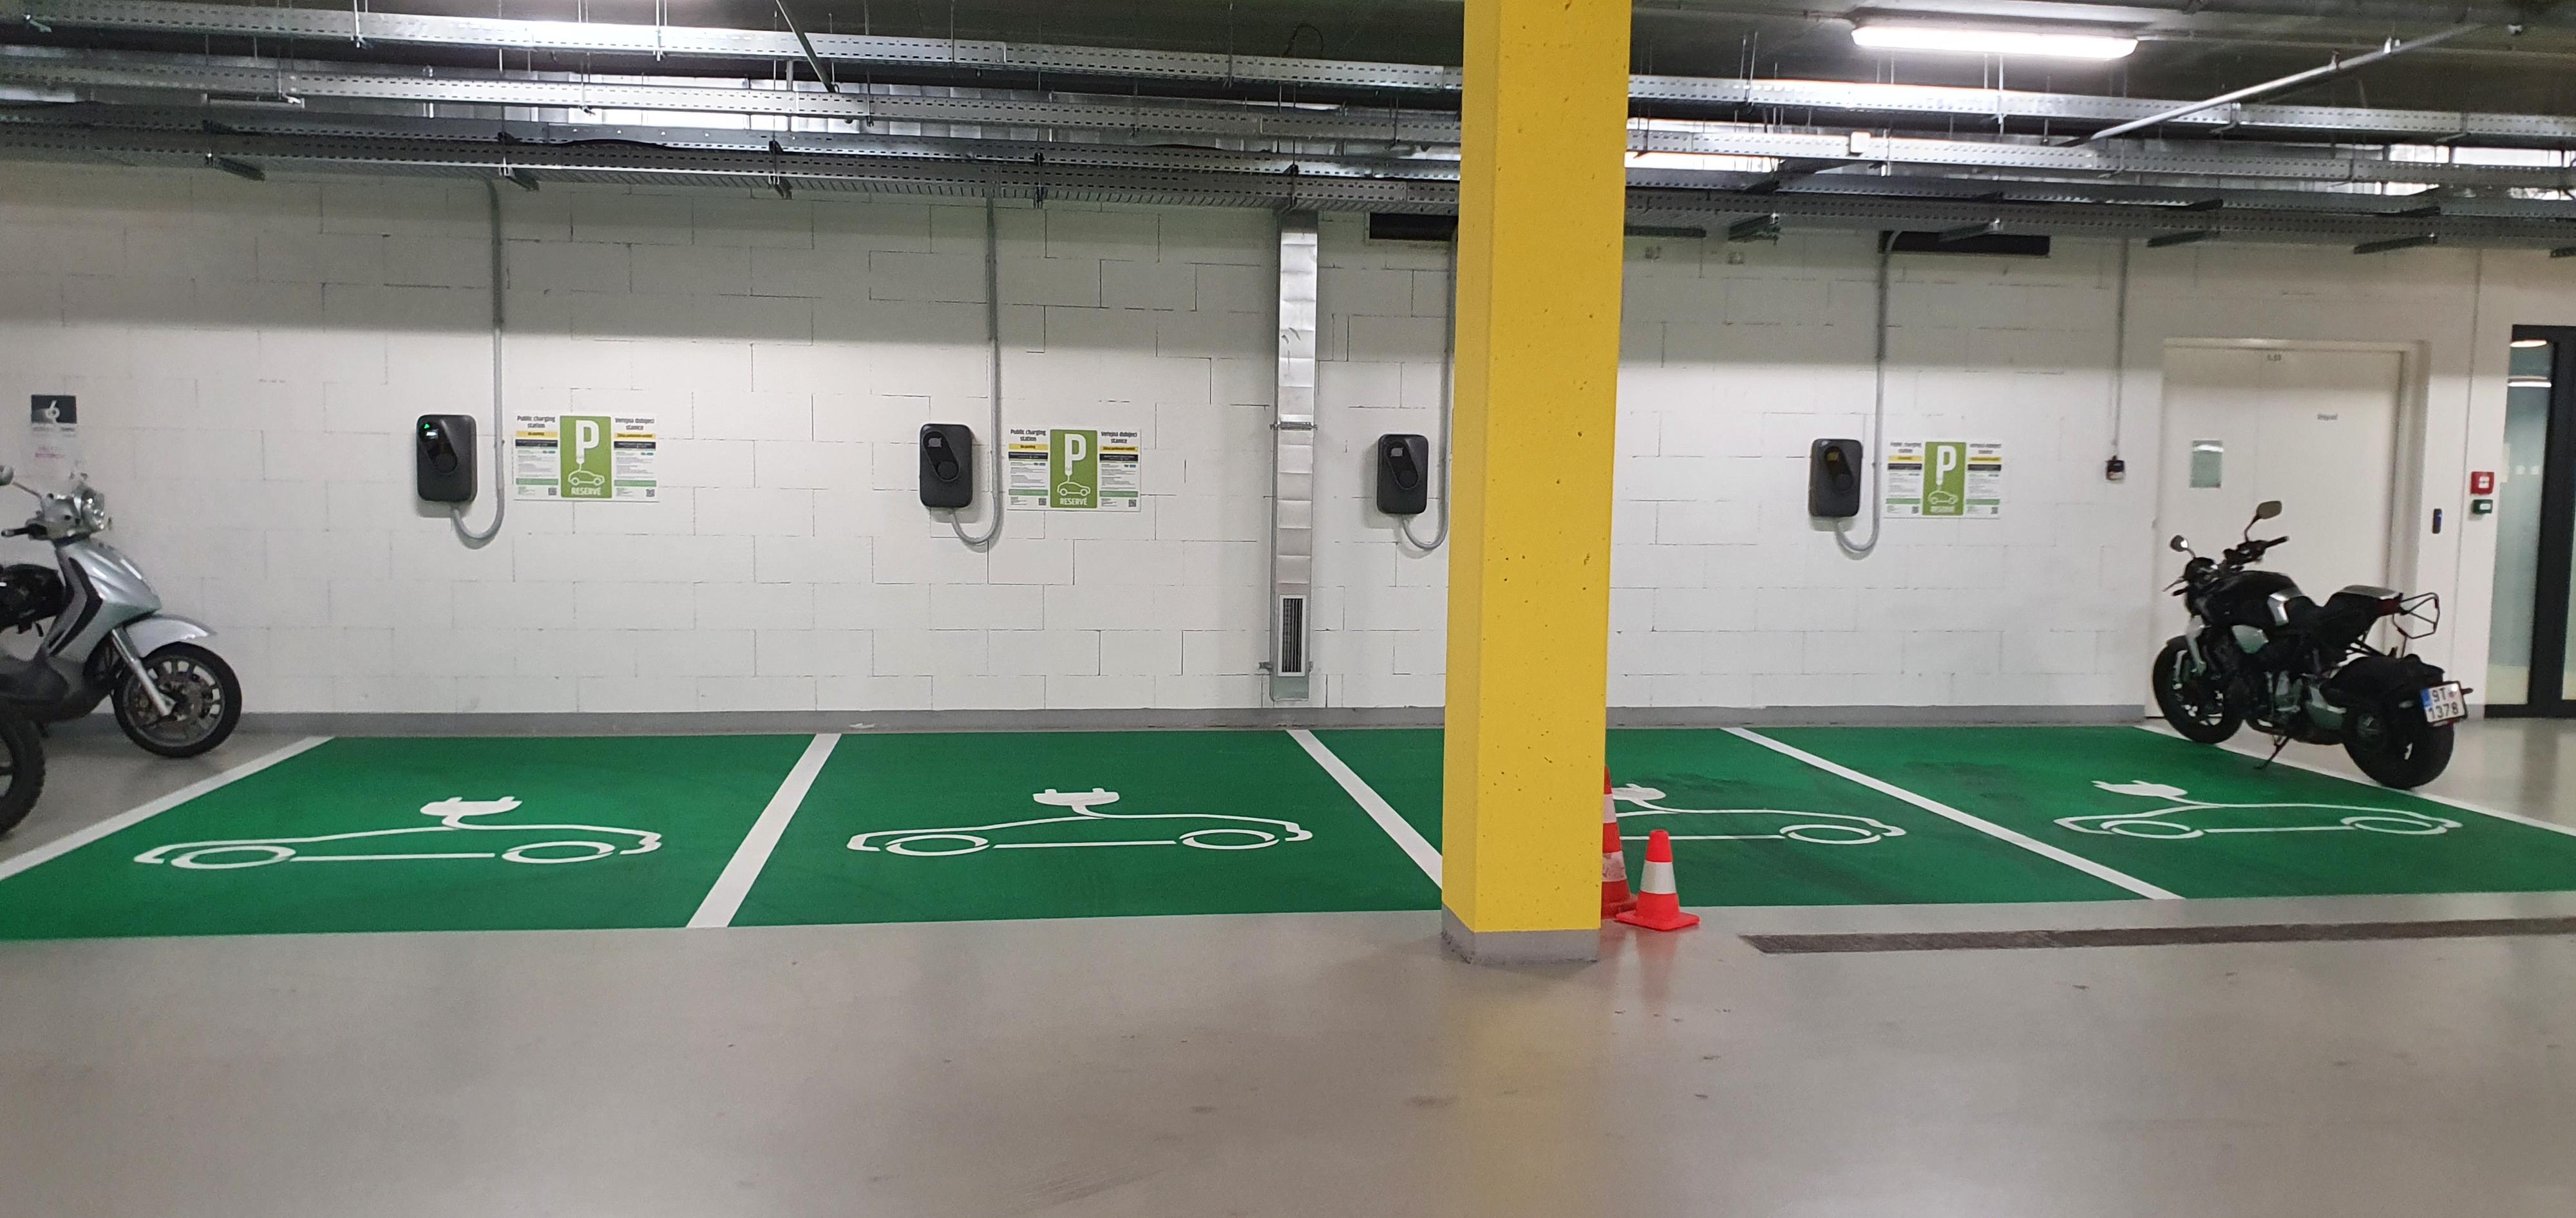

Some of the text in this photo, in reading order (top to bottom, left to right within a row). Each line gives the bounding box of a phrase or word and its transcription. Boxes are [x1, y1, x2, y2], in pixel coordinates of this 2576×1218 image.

[576, 420, 600, 458] P
[1065, 434, 1086, 472] P
[1936, 445, 1956, 483] P
[2428, 702, 2459, 720] 1378
[2432, 688, 2446, 702] 9T
